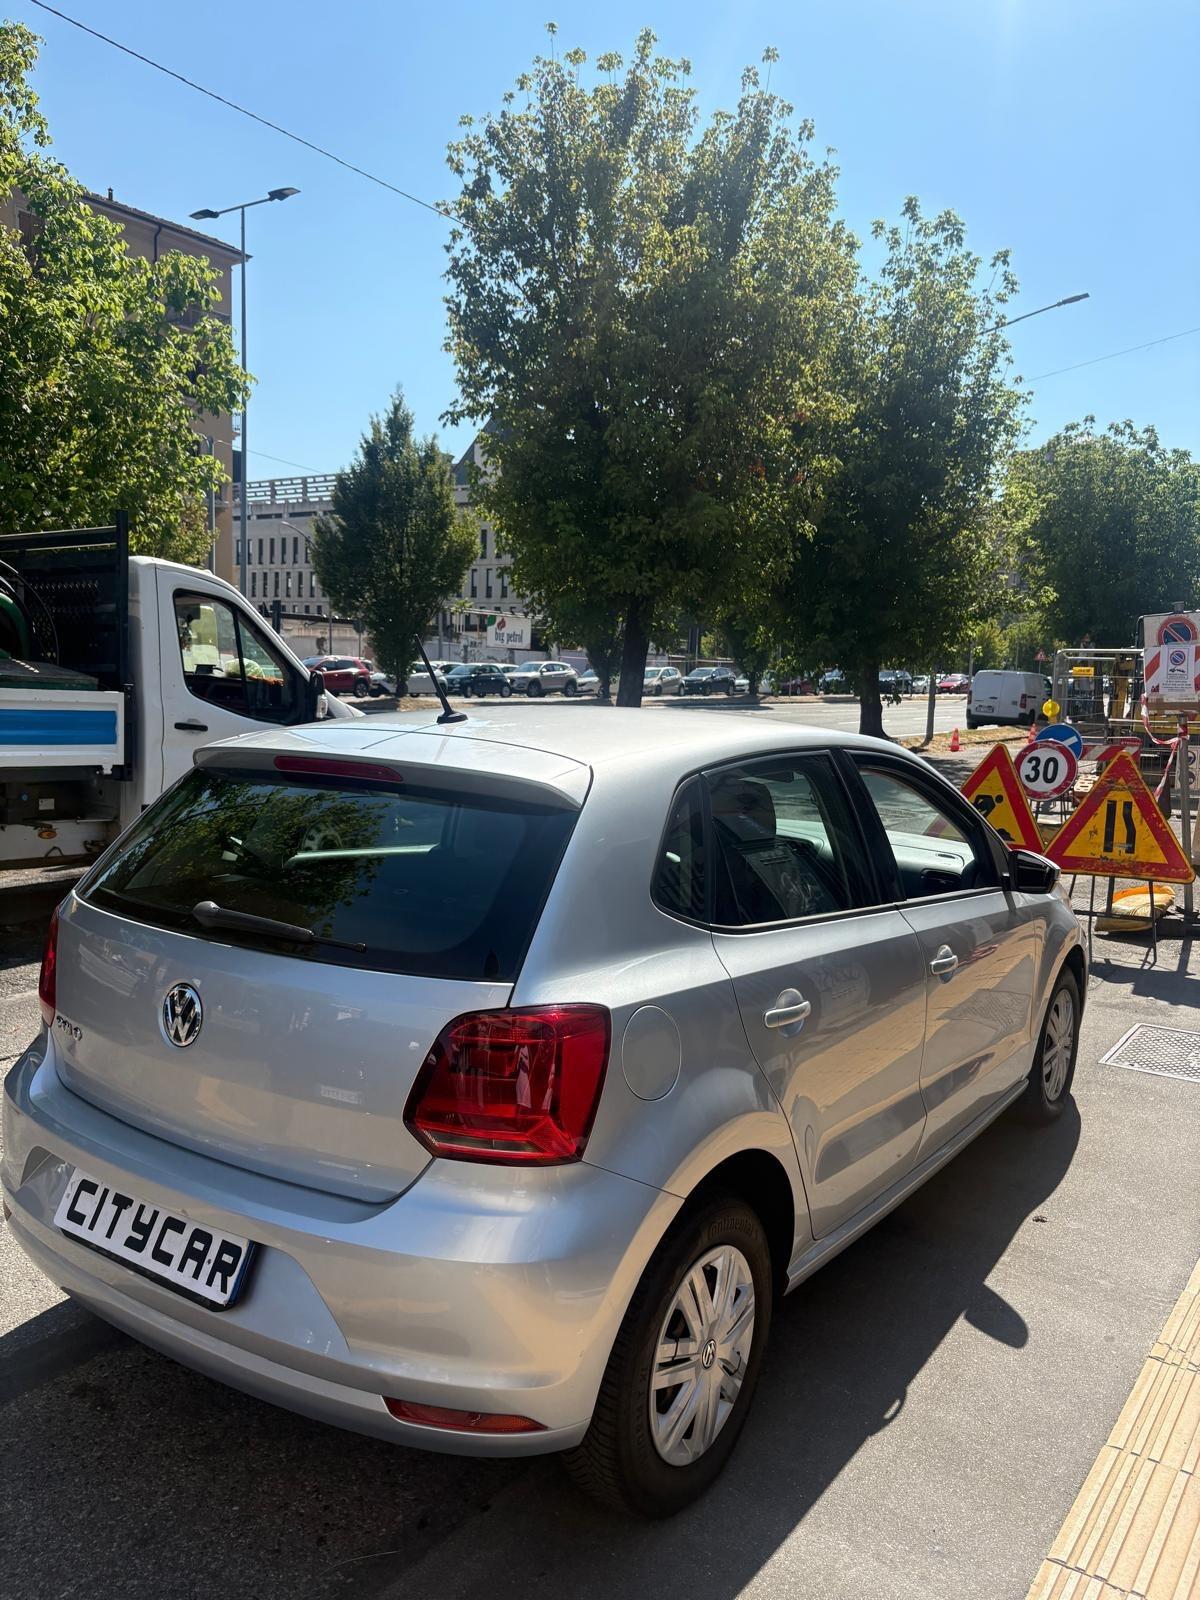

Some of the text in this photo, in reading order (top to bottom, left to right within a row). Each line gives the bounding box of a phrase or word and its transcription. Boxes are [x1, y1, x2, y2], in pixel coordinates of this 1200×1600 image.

[506, 629, 523, 644] petrol
[1025, 756, 1059, 784] 30
[66, 1178, 243, 1294] CITYCAR
